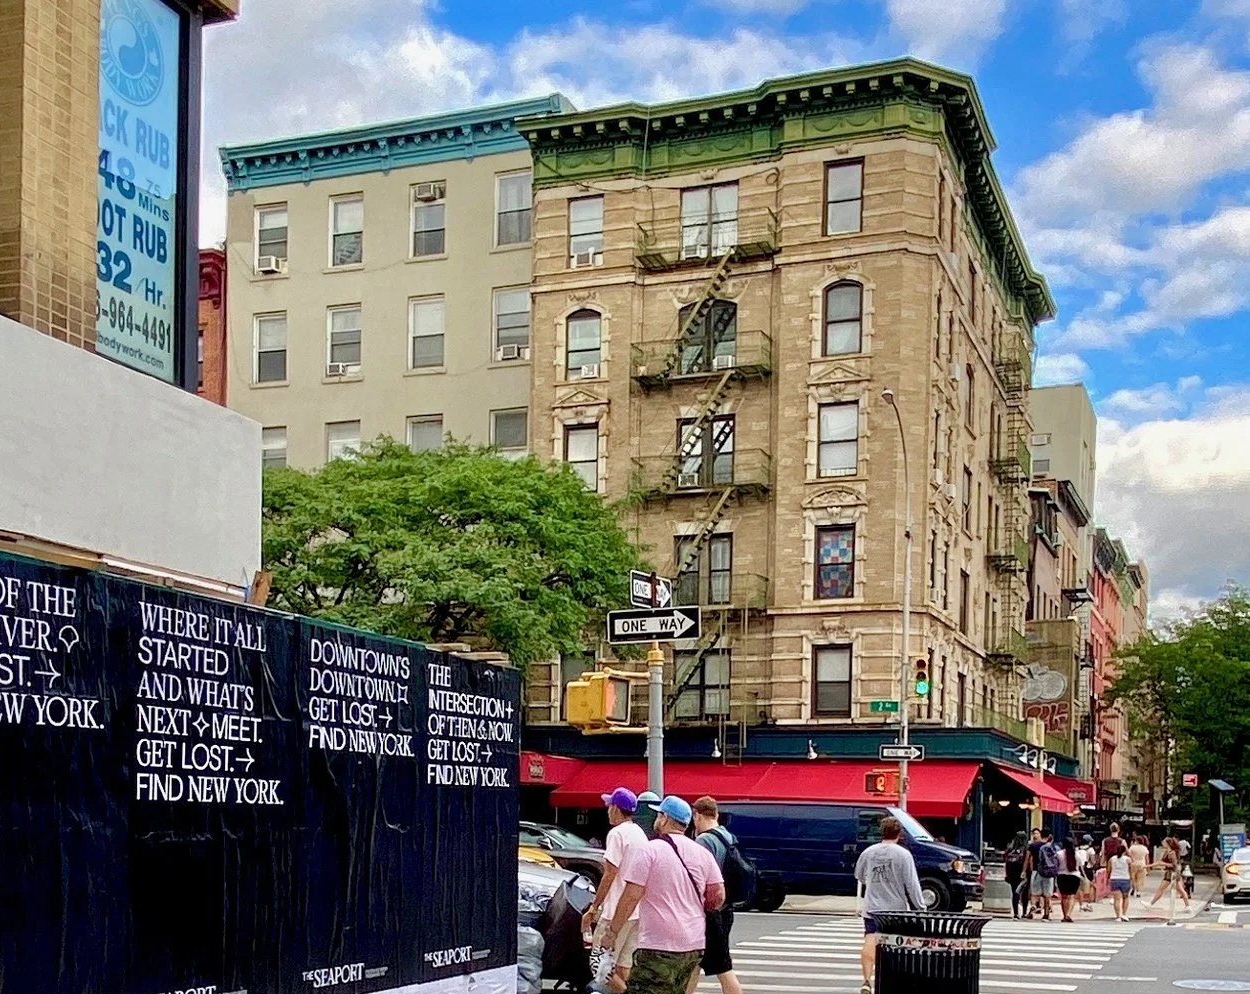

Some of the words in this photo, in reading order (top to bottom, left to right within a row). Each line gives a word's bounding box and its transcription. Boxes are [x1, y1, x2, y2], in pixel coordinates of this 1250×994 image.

[100, 98, 129, 148] CK
[136, 117, 170, 170] RUB
[138, 193, 170, 222] Mins
[96, 197, 127, 243] OT
[133, 214, 167, 264] RUB
[26, 580, 77, 618] THE
[634, 582, 649, 597] ONE
[138, 601, 211, 641] WHERE
[213, 616, 234, 647] IT
[234, 621, 267, 653] ALL
[621, 619, 647, 633] ONE
[658, 617, 686, 631] WAY
[137, 635, 229, 677] STARTED
[137, 670, 183, 703] AND
[186, 676, 254, 712] WHAT'S
[309, 667, 397, 704] DOWNTOWN.
[427, 662, 451, 687] THE
[33, 694, 105, 731] YORK.
[308, 696, 339, 723] GET
[342, 700, 378, 727] LOST.
[427, 688, 505, 718] INTERSECTION
[136, 703, 192, 737] NEXT
[212, 713, 263, 744] MEET.
[427, 713, 446, 735] OF
[445, 715, 478, 739] THEN
[487, 719, 514, 743] NOW.
[136, 738, 177, 769] GET
[181, 741, 235, 773] LOST.
[308, 724, 347, 752] FIND
[348, 728, 378, 754] NEW
[377, 731, 415, 758] YORK.
[427, 740, 450, 761] GET
[451, 742, 482, 764] LOST.
[136, 772, 184, 802] FIND
[187, 776, 233, 804] NEW
[234, 777, 284, 806] YORK.
[426, 763, 454, 786] FIND
[454, 764, 480, 787] NEW
[480, 765, 510, 788] YORK.
[432, 946, 472, 968] SEAPORT
[313, 963, 364, 988] SEAPORT
